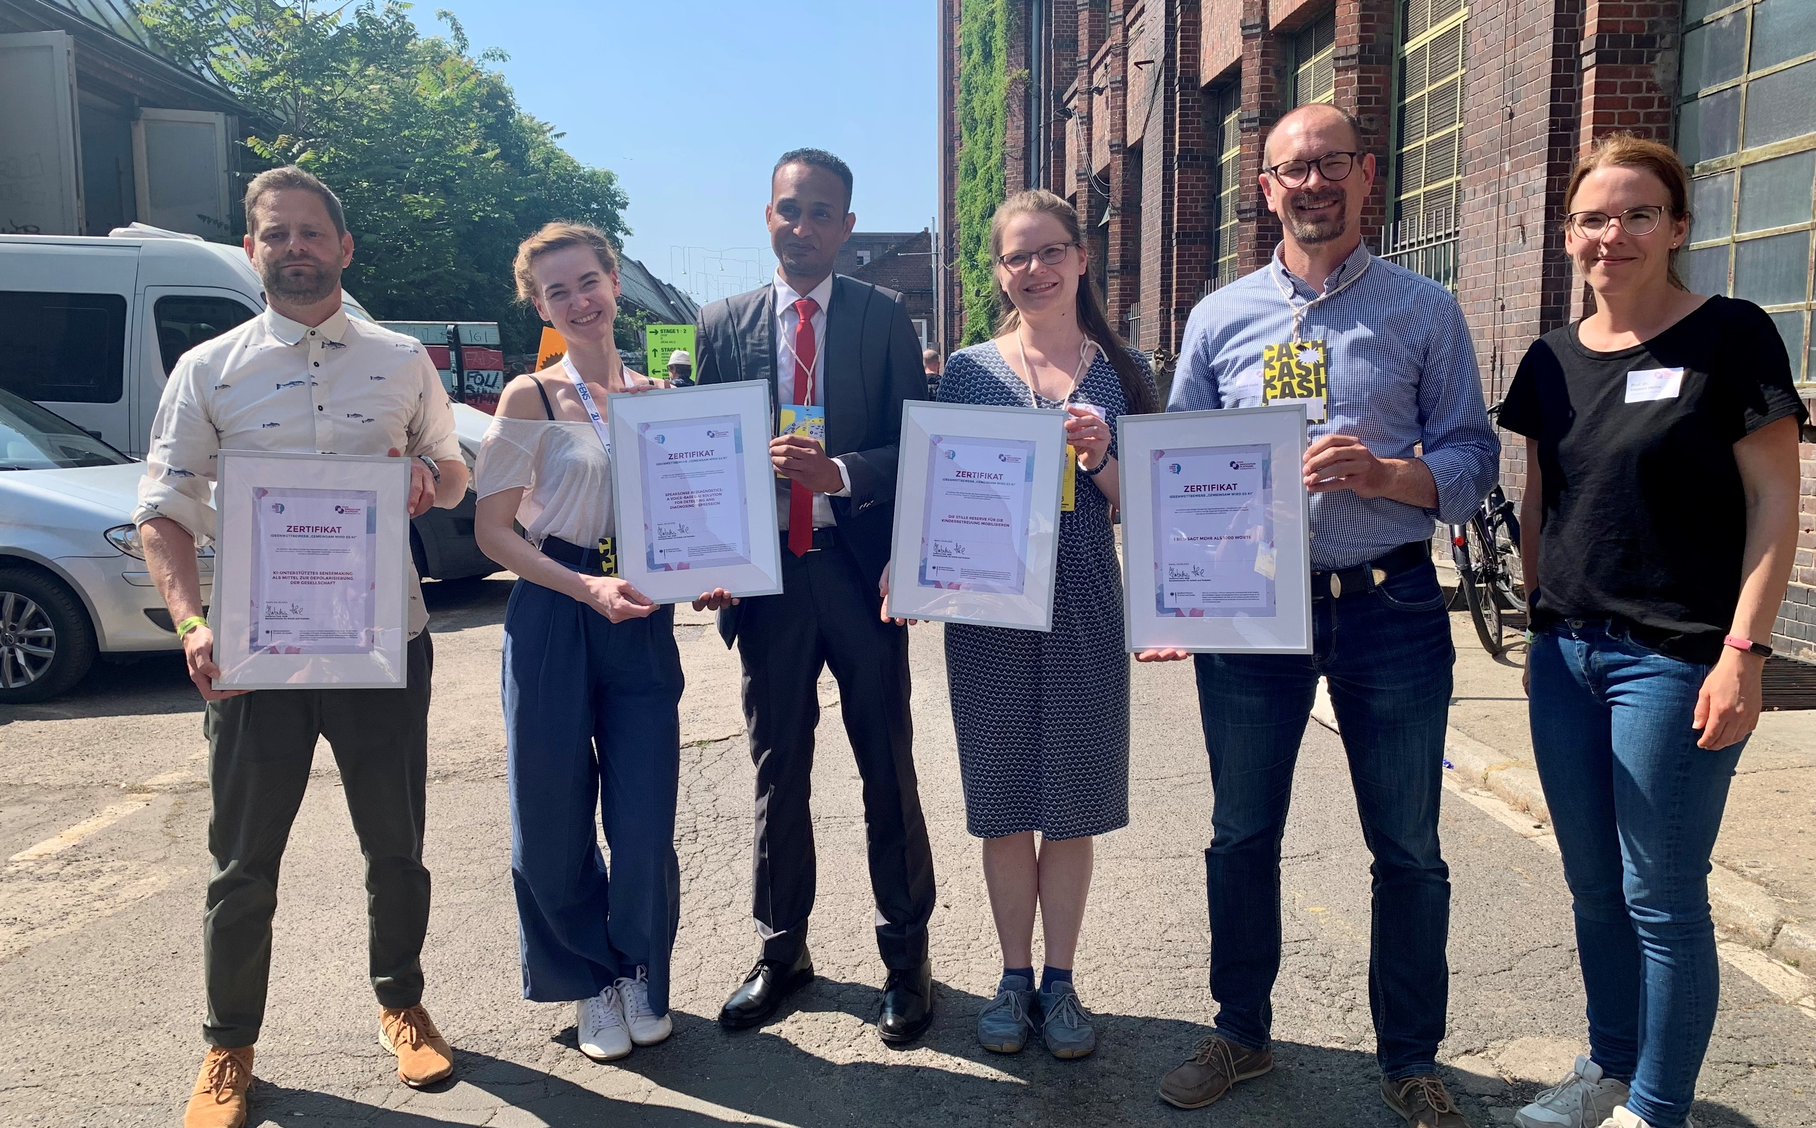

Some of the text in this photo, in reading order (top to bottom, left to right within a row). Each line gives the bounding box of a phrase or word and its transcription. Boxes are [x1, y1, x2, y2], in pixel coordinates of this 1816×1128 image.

[1263, 356, 1327, 385] CASH
[577, 382, 591, 400] FENS
[1262, 376, 1327, 405] CASH
[668, 450, 715, 460] ZERTIFIKAT
[956, 470, 1003, 480] ZERTIFIKAT
[1184, 483, 1238, 493] ZERTIFIKAT
